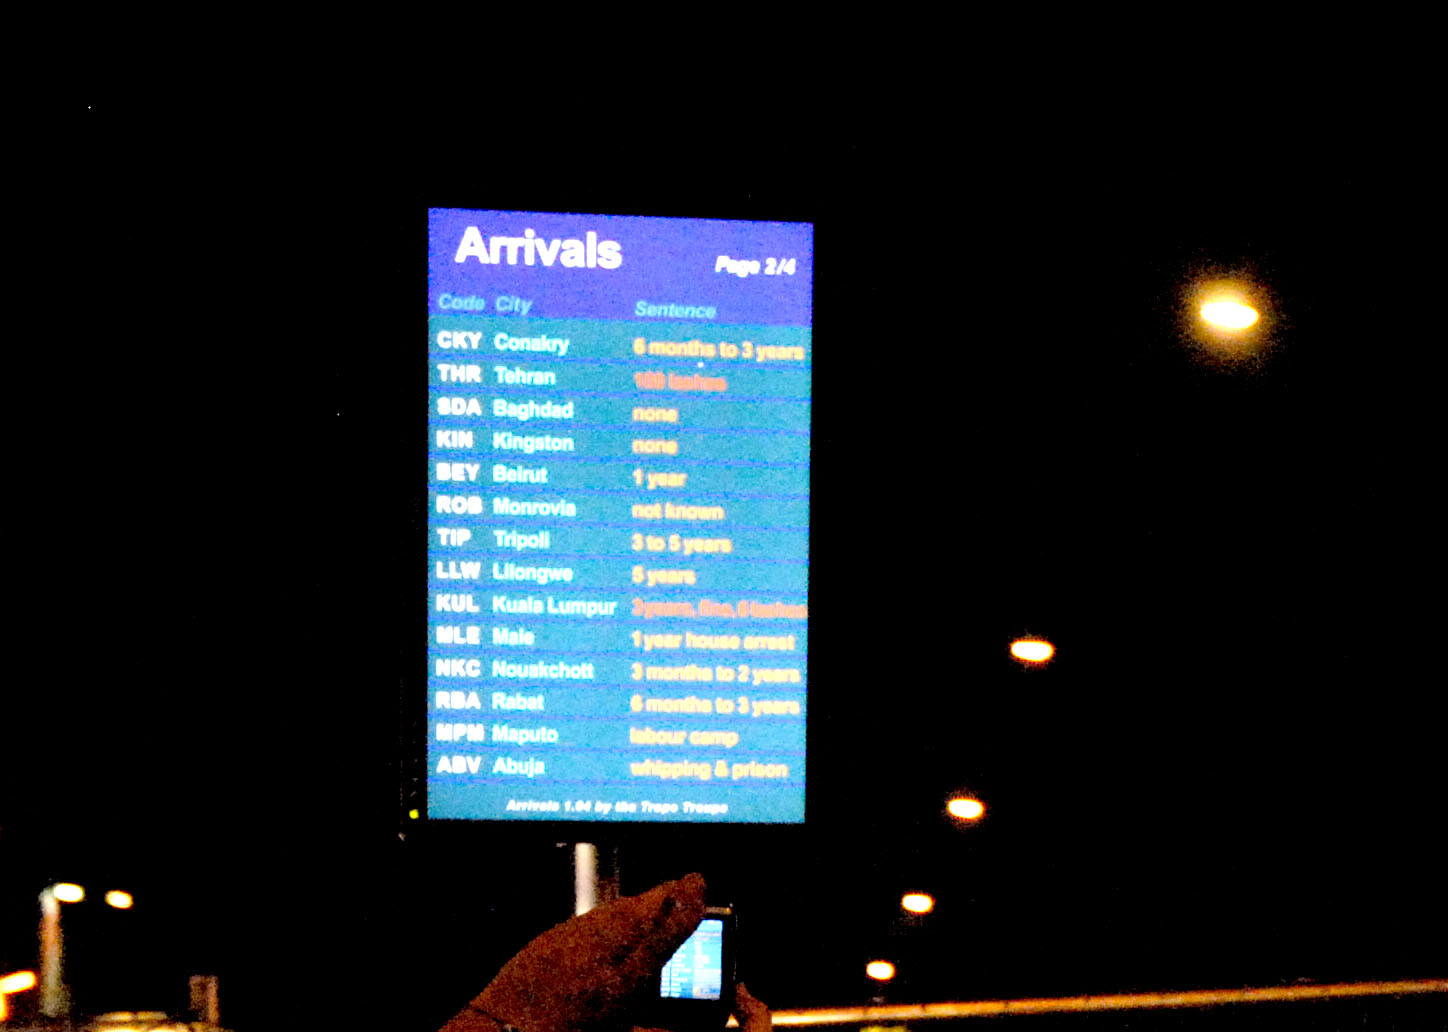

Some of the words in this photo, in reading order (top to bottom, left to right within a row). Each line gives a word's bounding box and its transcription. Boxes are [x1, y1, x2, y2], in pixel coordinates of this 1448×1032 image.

[455, 227, 622, 269] Arrivals
[715, 256, 760, 277] Page
[765, 258, 796, 275] 2/4
[438, 293, 485, 311] Code
[495, 296, 533, 317] City
[634, 300, 717, 319] Sentence
[437, 331, 482, 348] CKY
[495, 334, 568, 355] Conakry
[634, 338, 646, 355] 6
[648, 340, 716, 357] months
[719, 342, 739, 358] to
[742, 341, 754, 358] 3
[756, 346, 805, 362] years
[438, 364, 481, 382] THR
[495, 367, 555, 384] Tehran
[494, 400, 573, 420] Baghdad
[633, 407, 678, 422] none
[437, 430, 473, 448] KIN
[494, 433, 573, 453] Kingston
[632, 440, 678, 454] none
[437, 463, 479, 481] BEY
[494, 465, 547, 482] Beirut
[633, 468, 643, 485] 1
[647, 473, 687, 489] year
[437, 496, 483, 514] ROB
[494, 498, 576, 516] Monrovia
[632, 503, 663, 519] not
[664, 502, 725, 520] known
[437, 528, 471, 546] TIP
[494, 531, 549, 550] Tripoli
[632, 533, 644, 551] 3
[646, 536, 666, 551] to
[669, 534, 681, 551] 5
[683, 538, 732, 555] years
[437, 562, 480, 579] LLW
[493, 563, 572, 584] Lilongwe
[632, 566, 645, 583] 5
[646, 570, 696, 587] years
[436, 594, 479, 612] KUL
[493, 596, 543, 613] Kuala
[548, 597, 616, 617] Lumpur
[437, 626, 480, 644] MLE
[493, 628, 534, 645] Male
[632, 631, 641, 647] 1
[643, 634, 683, 651] year
[685, 632, 741, 649] house
[743, 635, 795, 650] arrest
[436, 659, 480, 677] NKC
[493, 661, 593, 678] Nouakchott
[632, 662, 644, 680] 3
[646, 664, 713, 681] months
[716, 666, 736, 682] to
[738, 664, 751, 682] 2
[752, 668, 801, 685] years
[436, 691, 480, 709] RBA
[493, 693, 544, 709] Rabat
[646, 696, 713, 713] months
[715, 698, 735, 714] to
[752, 700, 801, 717] years
[436, 724, 484, 741] MPM
[493, 725, 558, 744] Maputo
[630, 727, 687, 745] labour
[688, 731, 739, 748] camp
[437, 756, 481, 773] ABV
[493, 758, 544, 777] Abuja
[630, 759, 712, 780] whipping
[714, 760, 730, 777] &
[732, 761, 789, 780] prison
